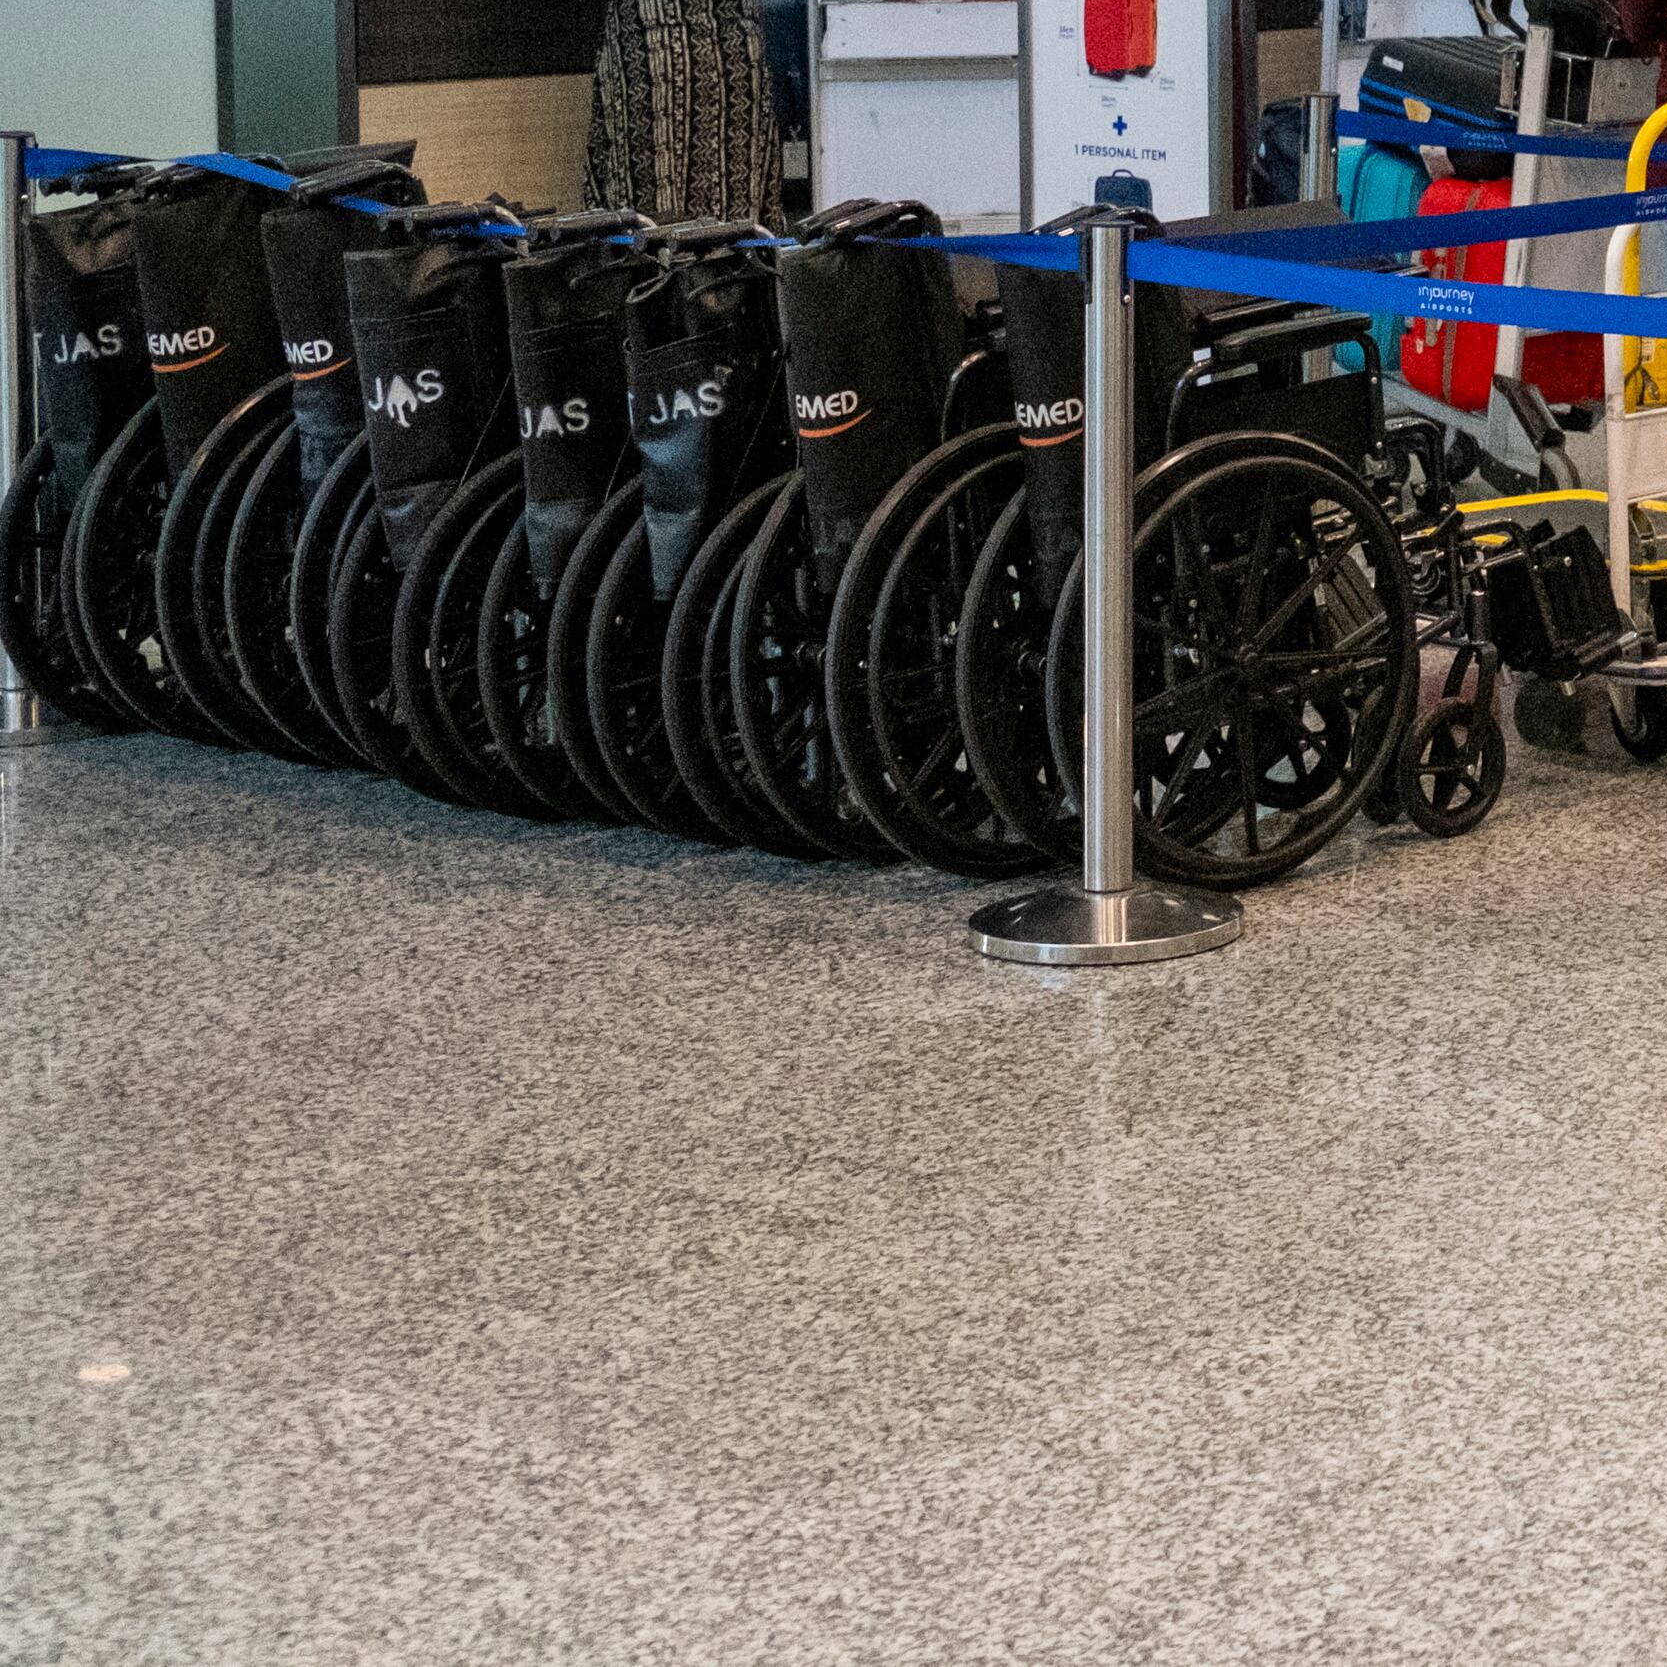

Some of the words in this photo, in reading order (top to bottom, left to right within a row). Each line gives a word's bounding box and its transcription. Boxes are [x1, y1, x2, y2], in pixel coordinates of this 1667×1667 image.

[1074, 144, 1079, 155] 1
[1081, 145, 1138, 160] PERSONAL
[1141, 149, 1167, 162] ITEM
[1418, 286, 1475, 306] injourney
[1420, 303, 1472, 315] AIRPORTS
[54, 323, 122, 364] JAS
[368, 368, 444, 428] JAS
[520, 398, 590, 439] JAS
[650, 381, 725, 424] JAS
